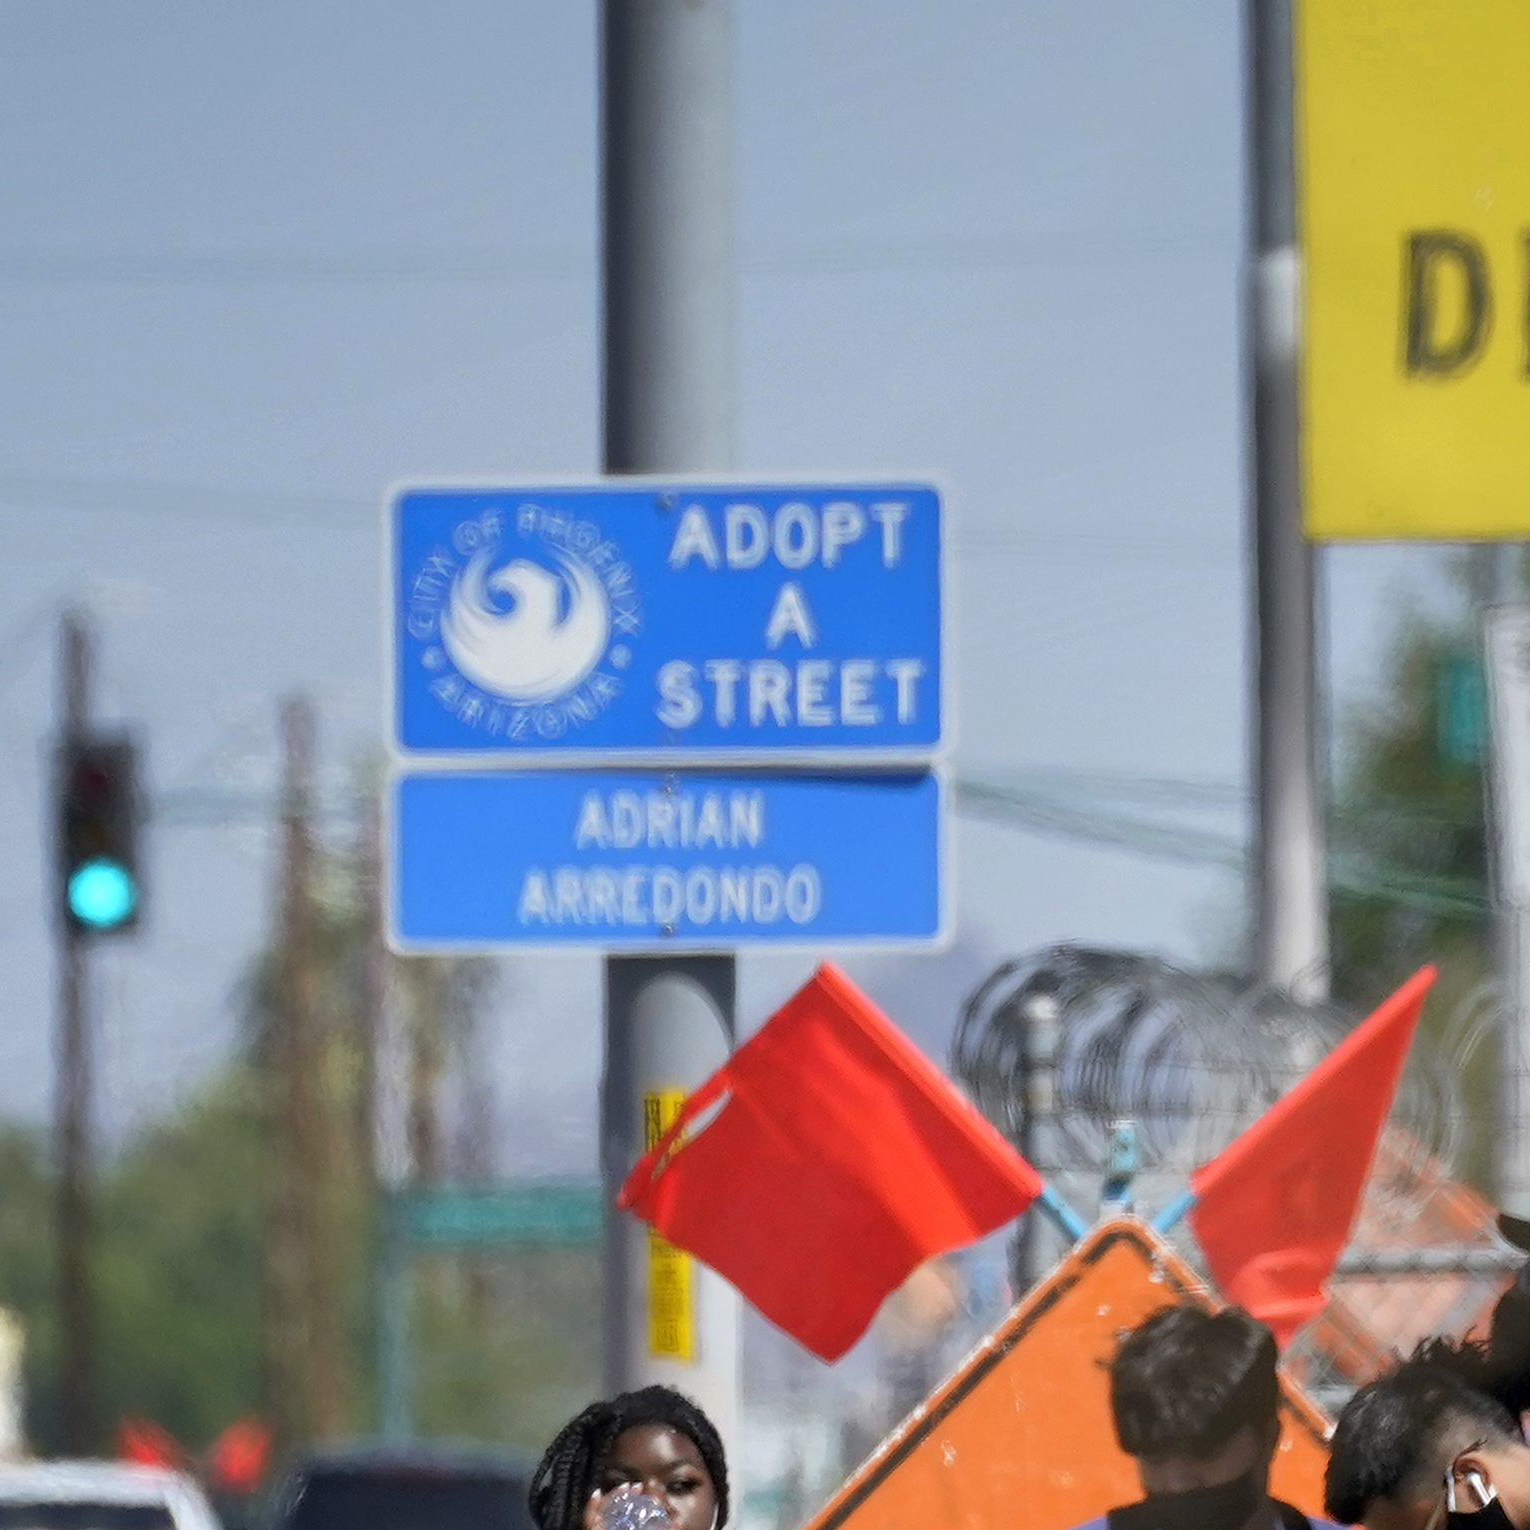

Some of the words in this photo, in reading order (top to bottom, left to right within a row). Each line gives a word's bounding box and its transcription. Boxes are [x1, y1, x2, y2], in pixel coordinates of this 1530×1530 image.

[670, 500, 911, 570] ADOPT
[766, 582, 815, 650] A
[654, 658, 925, 729] STREET
[575, 788, 764, 850] ADRIAN
[516, 860, 822, 926] ARREDONDO
